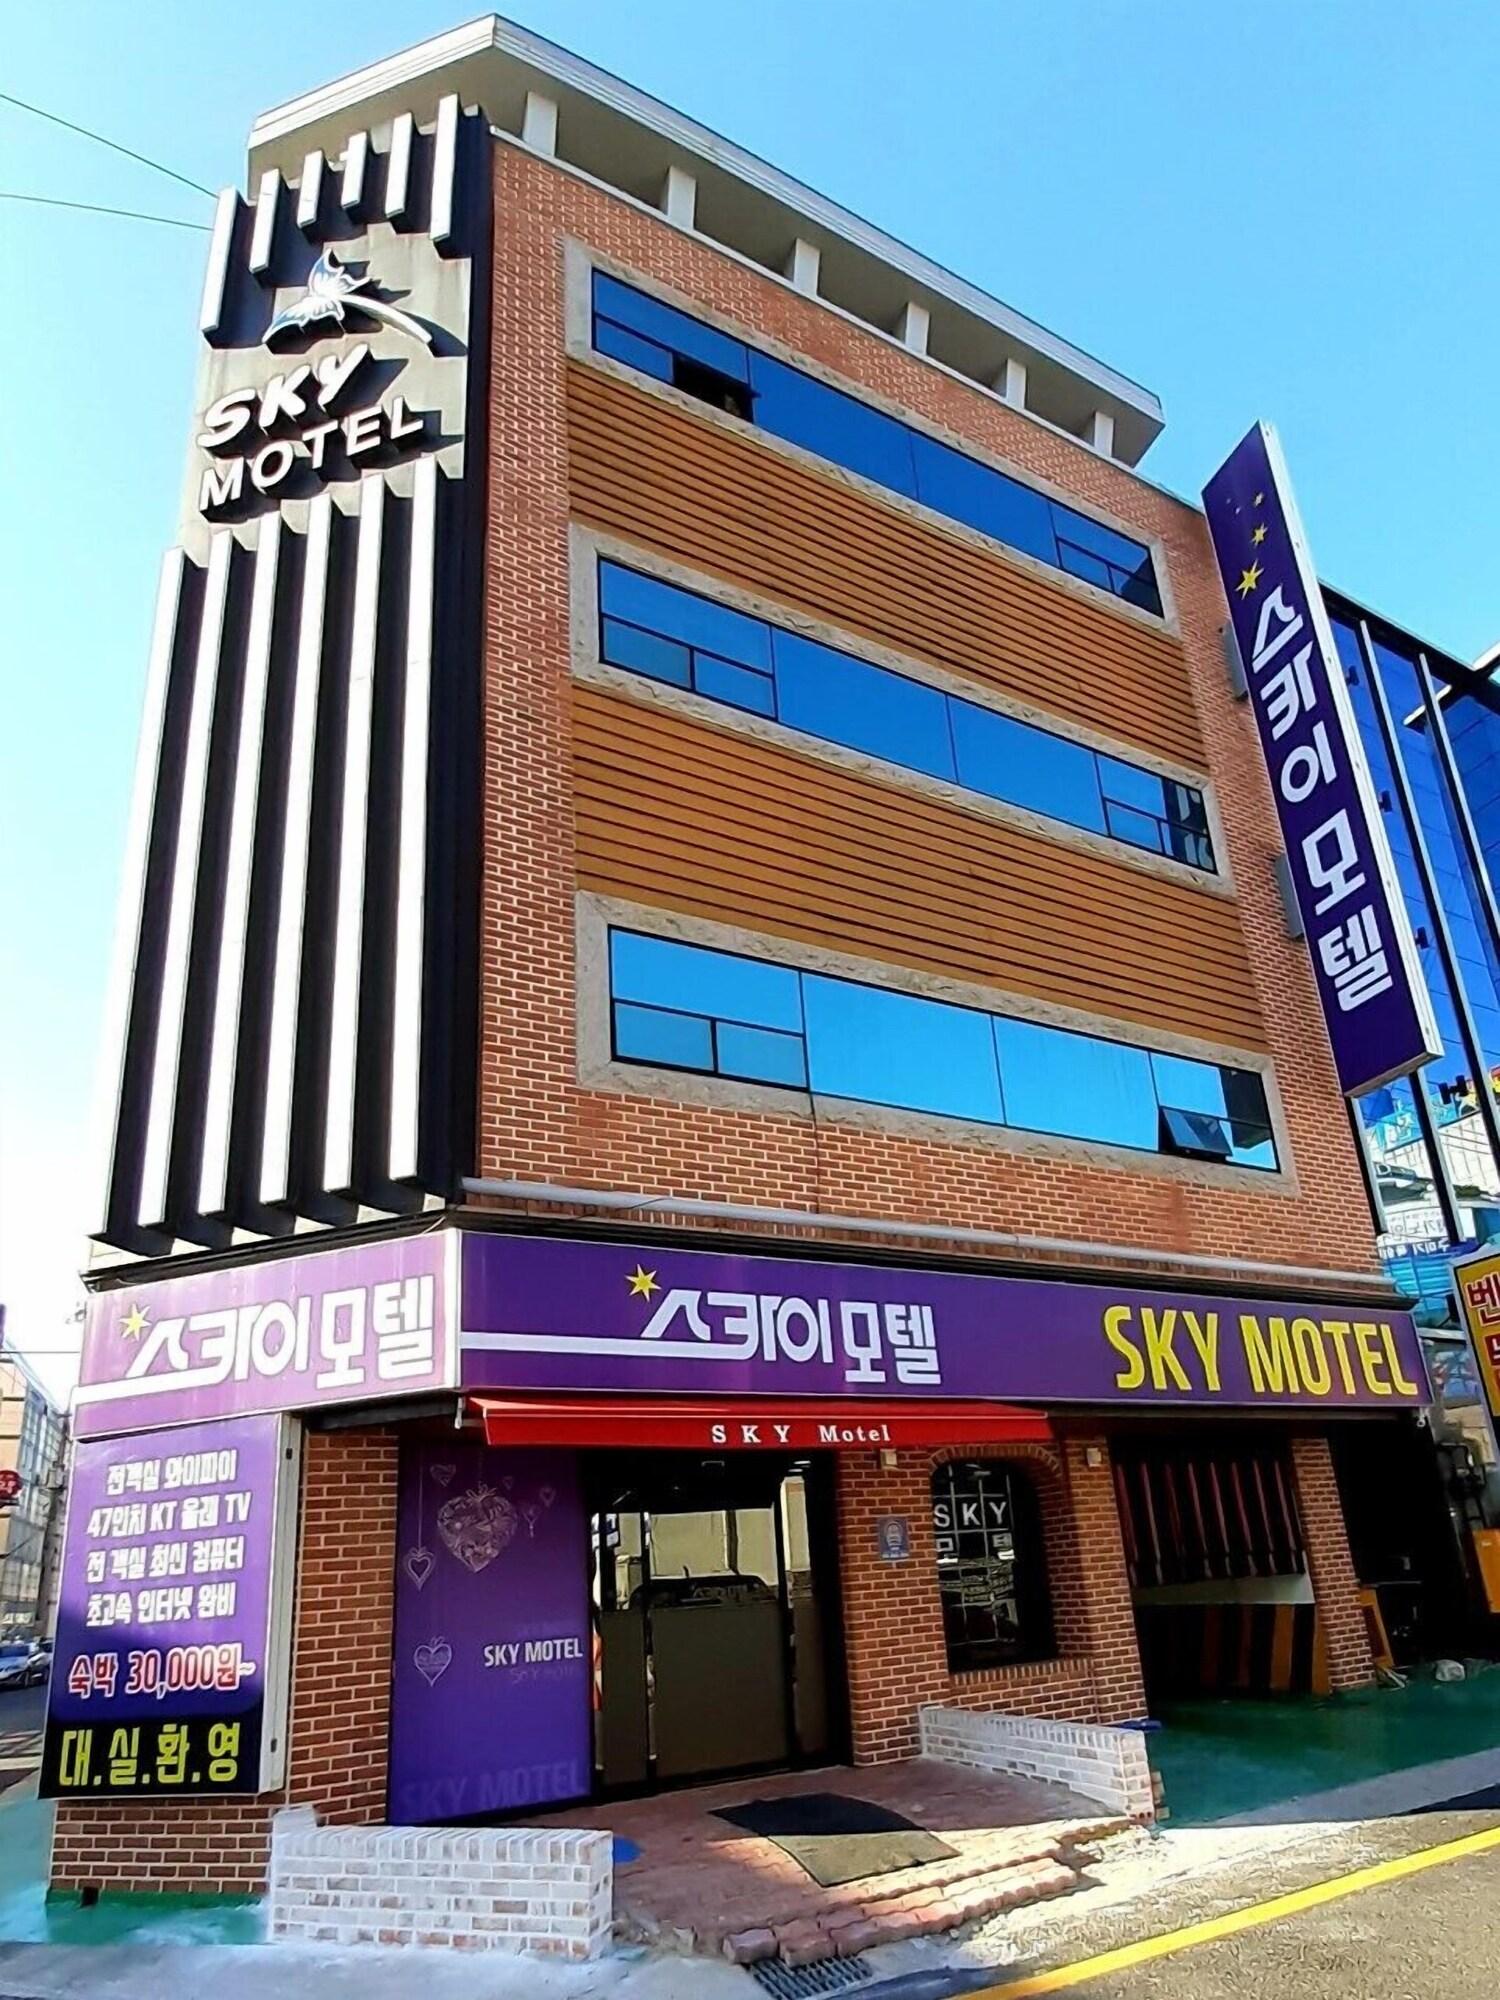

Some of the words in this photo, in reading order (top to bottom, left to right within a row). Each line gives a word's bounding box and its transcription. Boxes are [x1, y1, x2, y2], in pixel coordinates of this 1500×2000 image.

[196, 343, 369, 448] SKY
[199, 395, 424, 511] MOTEL
[1104, 1305, 1221, 1392] SKY
[1239, 1315, 1418, 1396] MOTEL
[711, 1424, 790, 1443] SKY
[817, 1424, 891, 1443] Motel
[163, 1449, 238, 1489] 와이파이
[86, 1502, 147, 1538] 47인치
[150, 1500, 178, 1532] KT
[224, 1491, 252, 1523] TV
[933, 1502, 1008, 1528] SKY
[149, 1542, 188, 1577] 최신
[192, 1535, 245, 1573] 컴퓨터
[86, 1592, 133, 1627] 초고속
[137, 1586, 194, 1623] 인터넷
[197, 1582, 237, 1618] 완비
[484, 1643, 520, 1668] SKY
[525, 1637, 584, 1663] MOTEL
[69, 1653, 118, 1699] 숙박
[402, 1777, 468, 1818] SKY
[479, 1759, 586, 1809] MOTEL
